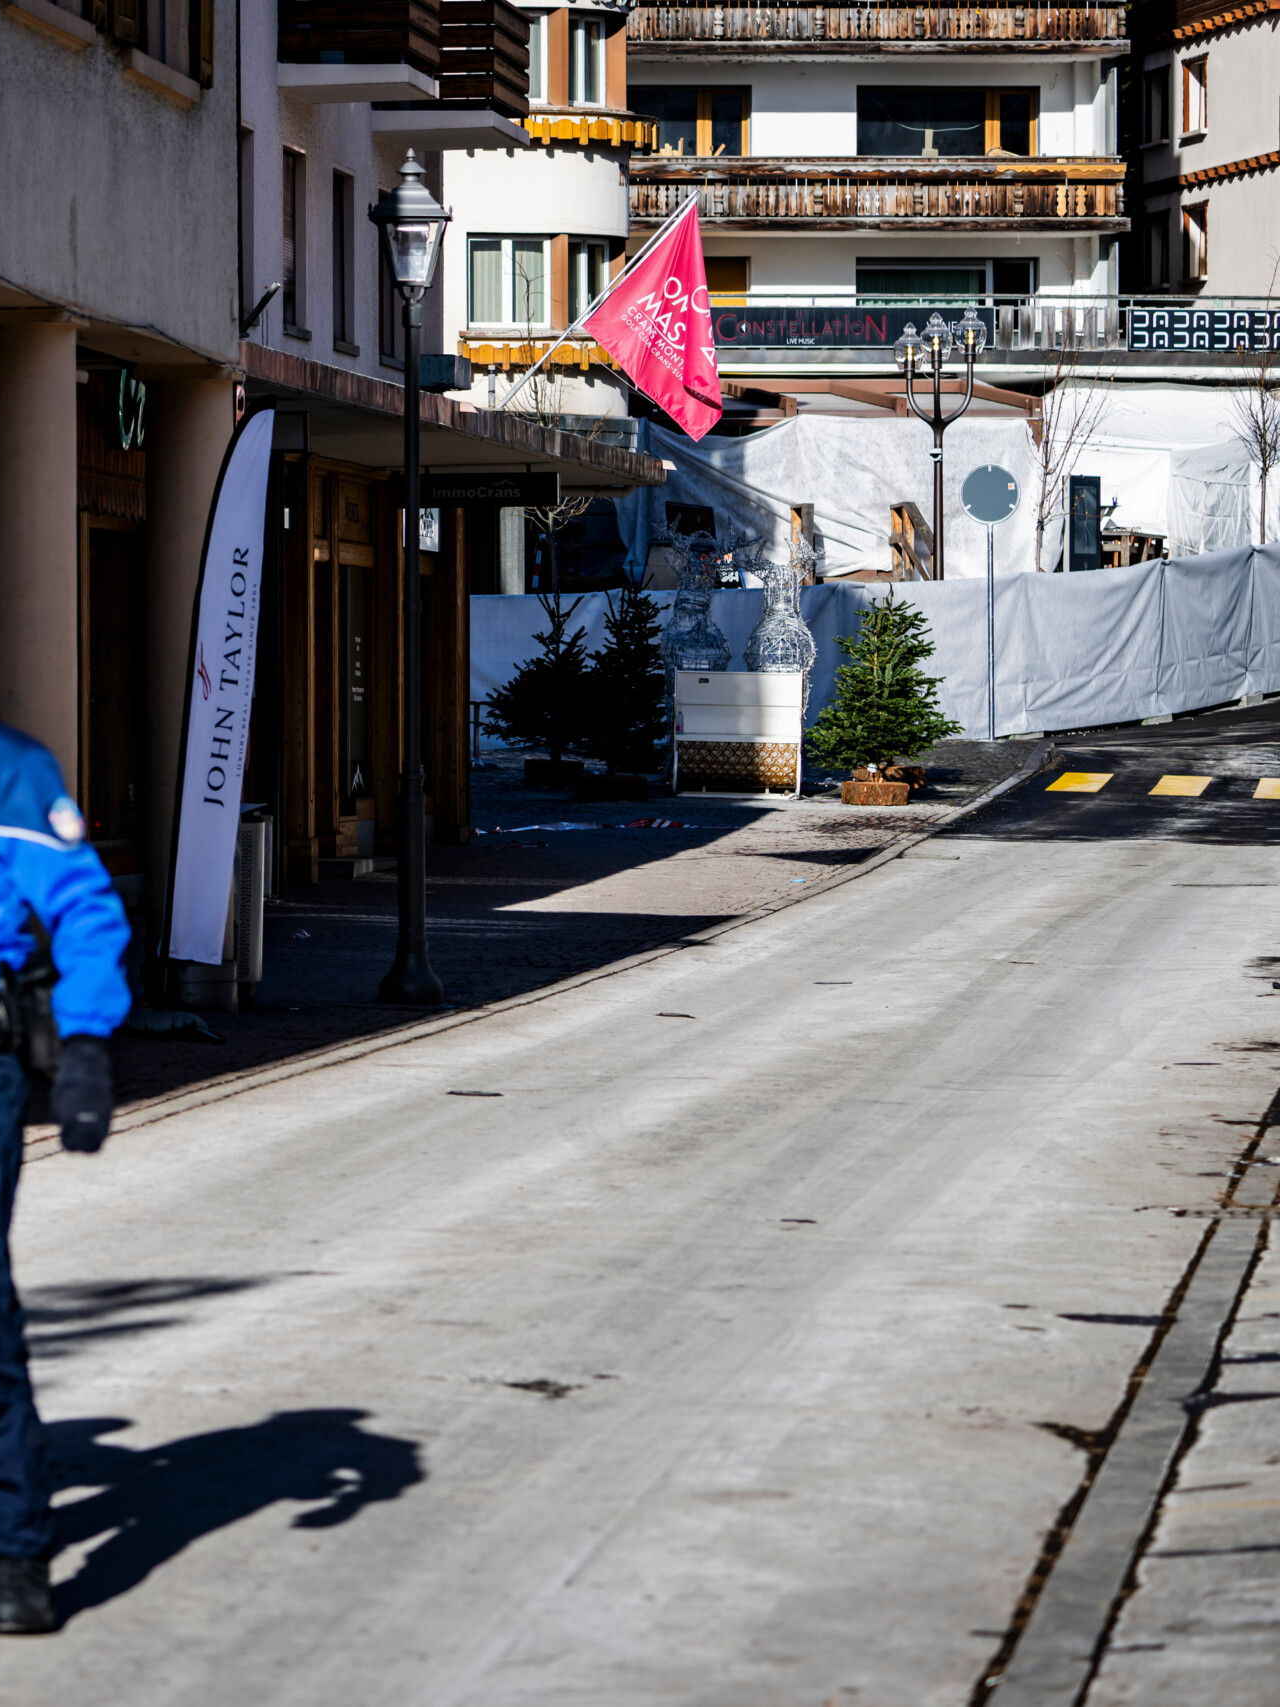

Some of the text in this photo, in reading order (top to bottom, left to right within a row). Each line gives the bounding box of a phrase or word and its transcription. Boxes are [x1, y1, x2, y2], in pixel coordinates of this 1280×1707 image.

[621, 314, 640, 336] GOLF
[627, 306, 658, 340] CRANS
[432, 486, 521, 499] ImmoCrans
[203, 546, 250, 808] JOHN TAYLOR
